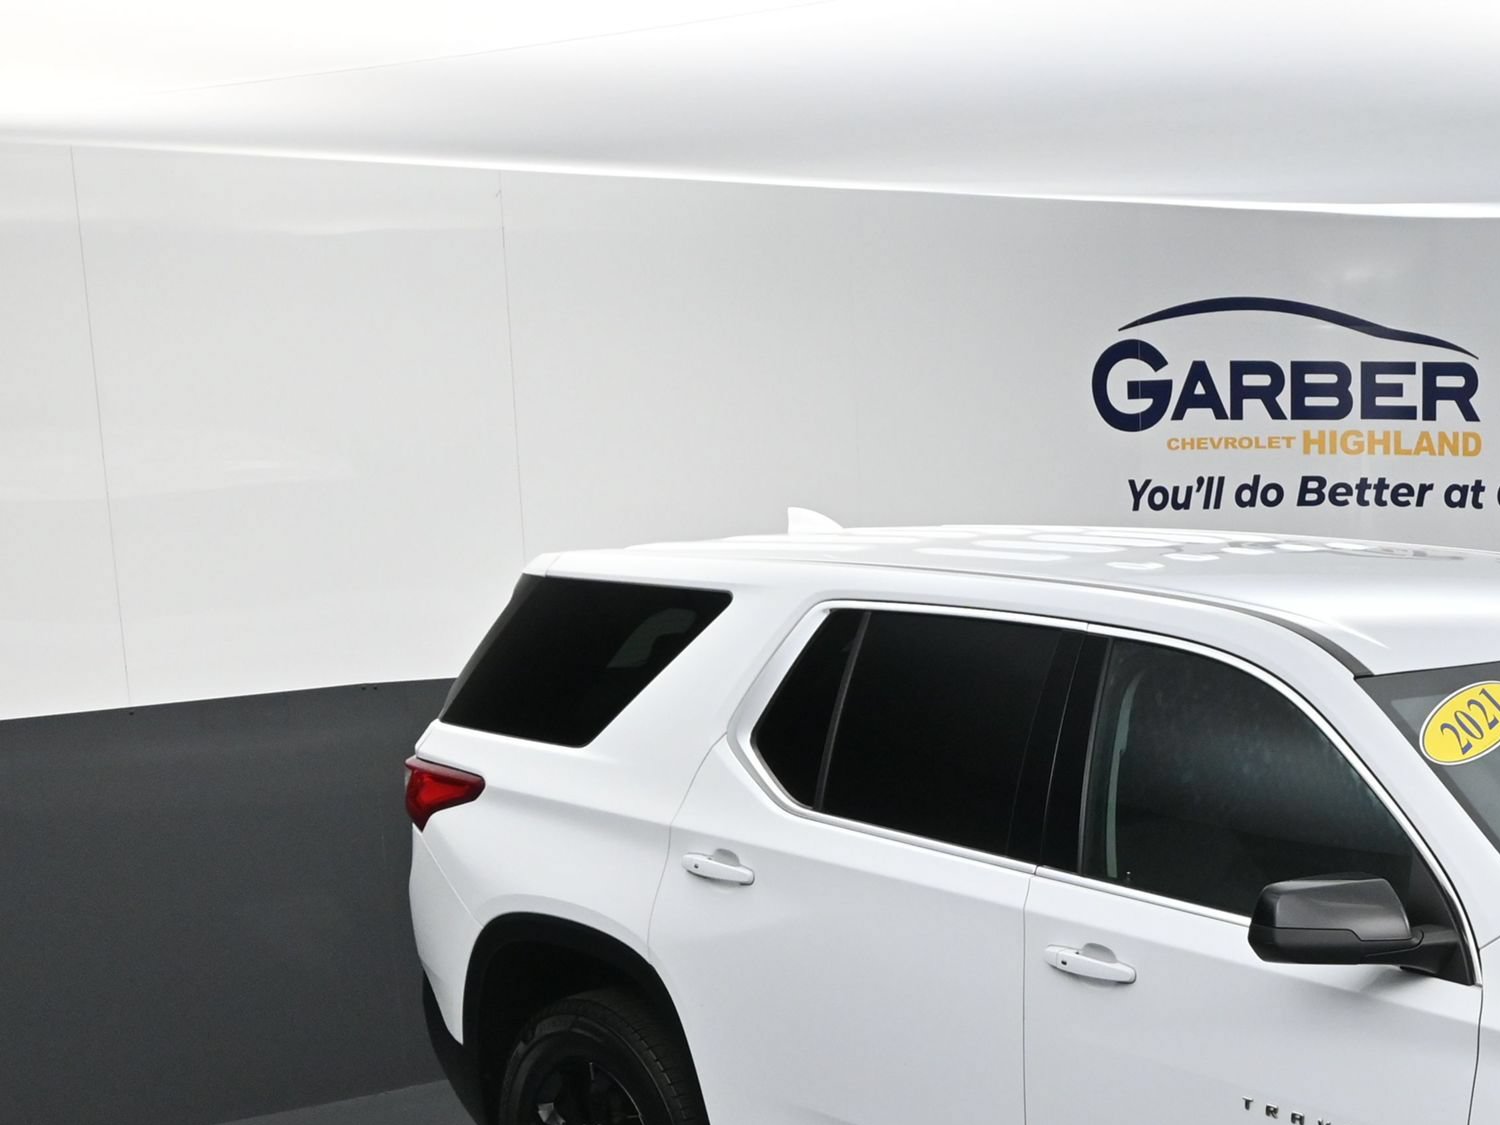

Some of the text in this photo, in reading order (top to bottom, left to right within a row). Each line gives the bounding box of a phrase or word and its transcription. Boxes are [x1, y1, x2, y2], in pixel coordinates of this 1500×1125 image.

[1092, 339, 1481, 433] GARBER
[1167, 430, 1482, 457] CHEVROLET HIGHLAND
[1127, 475, 1225, 511] You'll
[1235, 474, 1284, 509] do
[1296, 476, 1434, 508] Better
[1443, 479, 1485, 510] at
